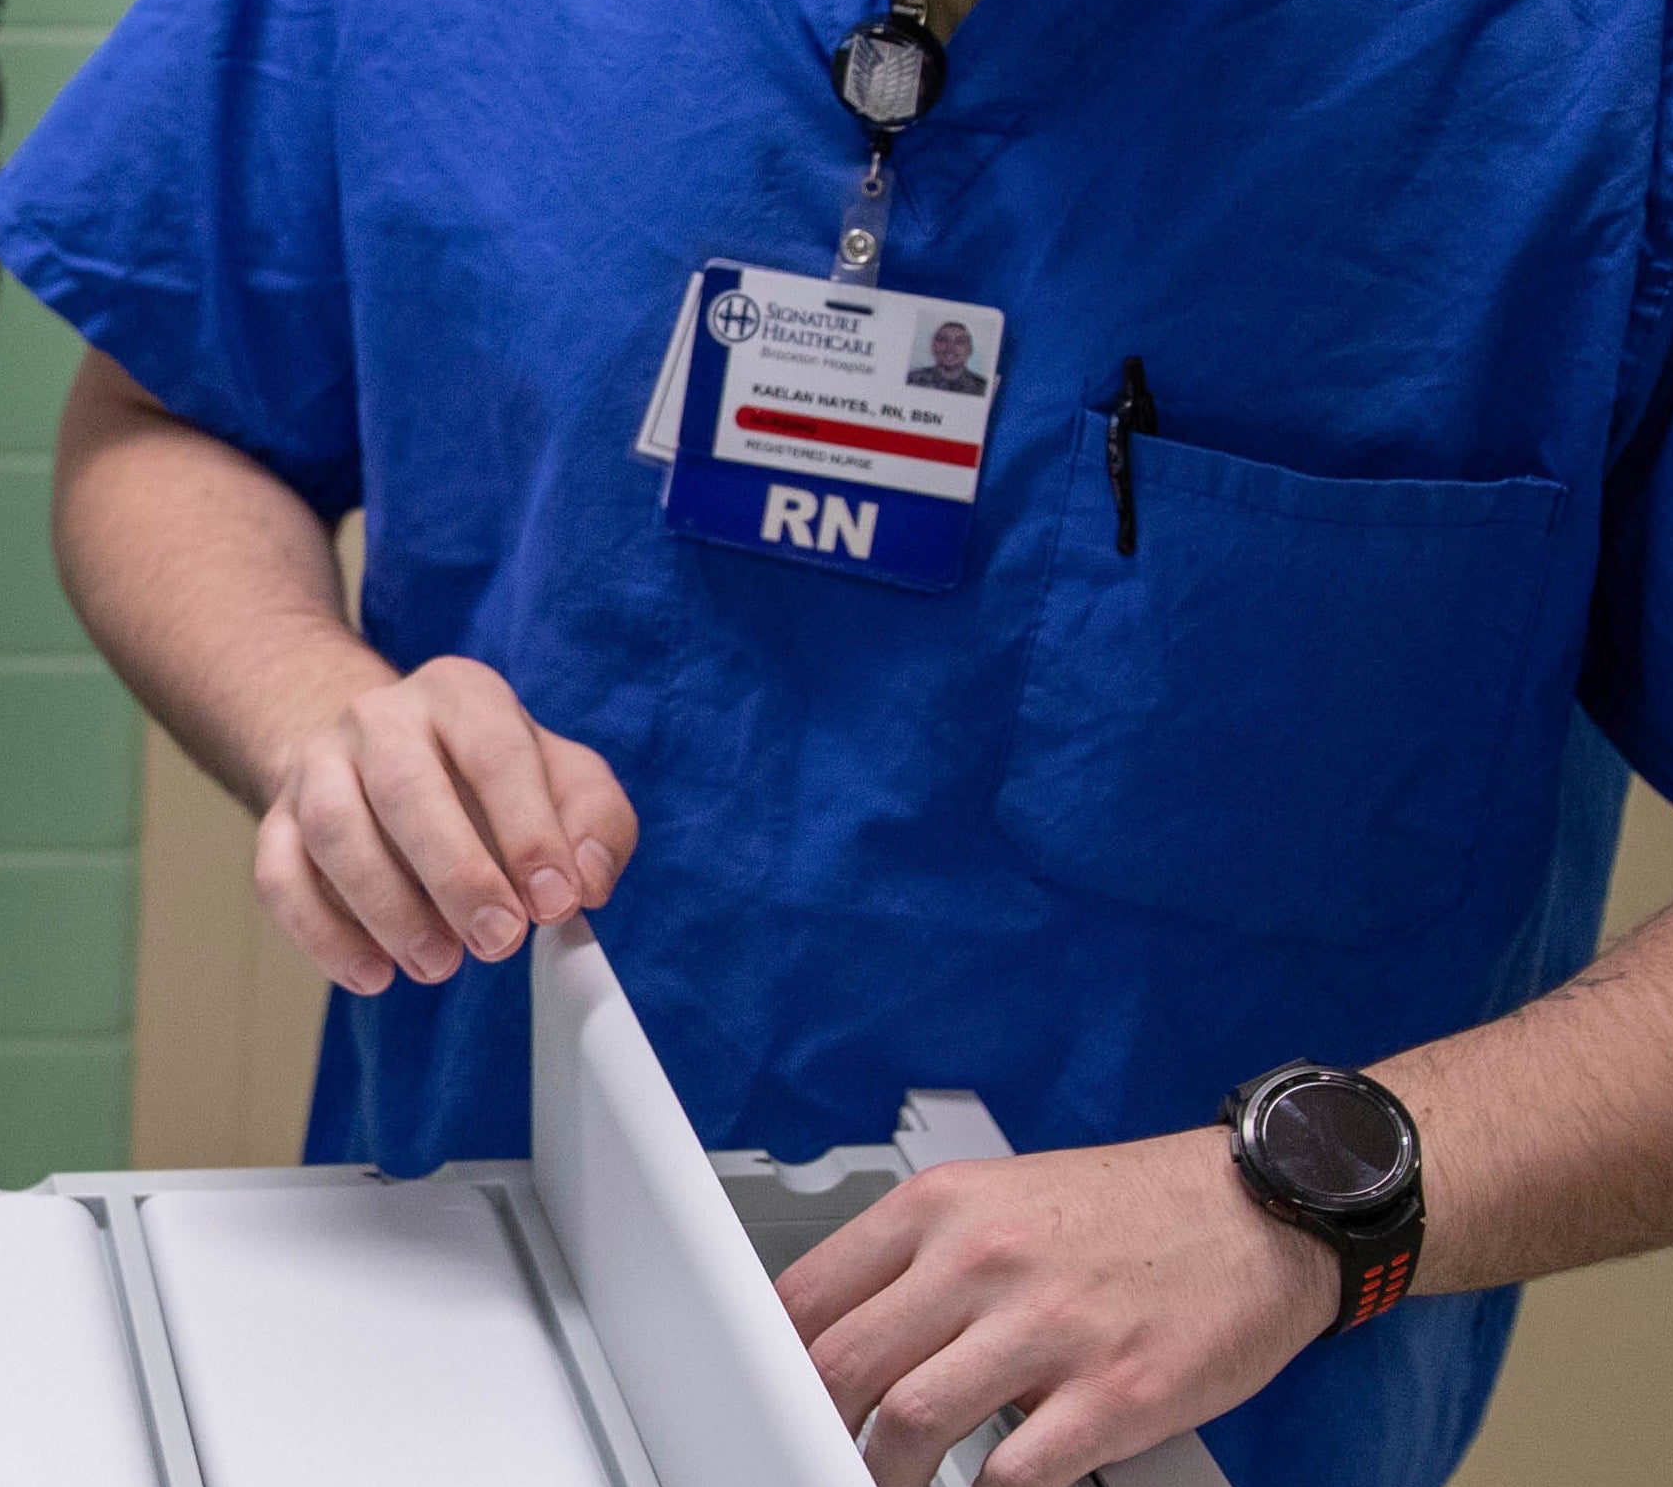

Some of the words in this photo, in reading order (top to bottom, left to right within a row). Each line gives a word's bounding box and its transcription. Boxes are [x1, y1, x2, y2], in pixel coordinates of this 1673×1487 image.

[767, 301, 861, 334] SIGNATURE
[762, 322, 874, 356] HEALTHCARE
[752, 383, 815, 404] KAELAN
[880, 404, 906, 422] RN,
[910, 408, 944, 426] BSN
[748, 413, 818, 435] NURSING
[745, 440, 827, 461] REGISTERED
[830, 453, 874, 470] NURSE
[759, 483, 880, 561] RN
